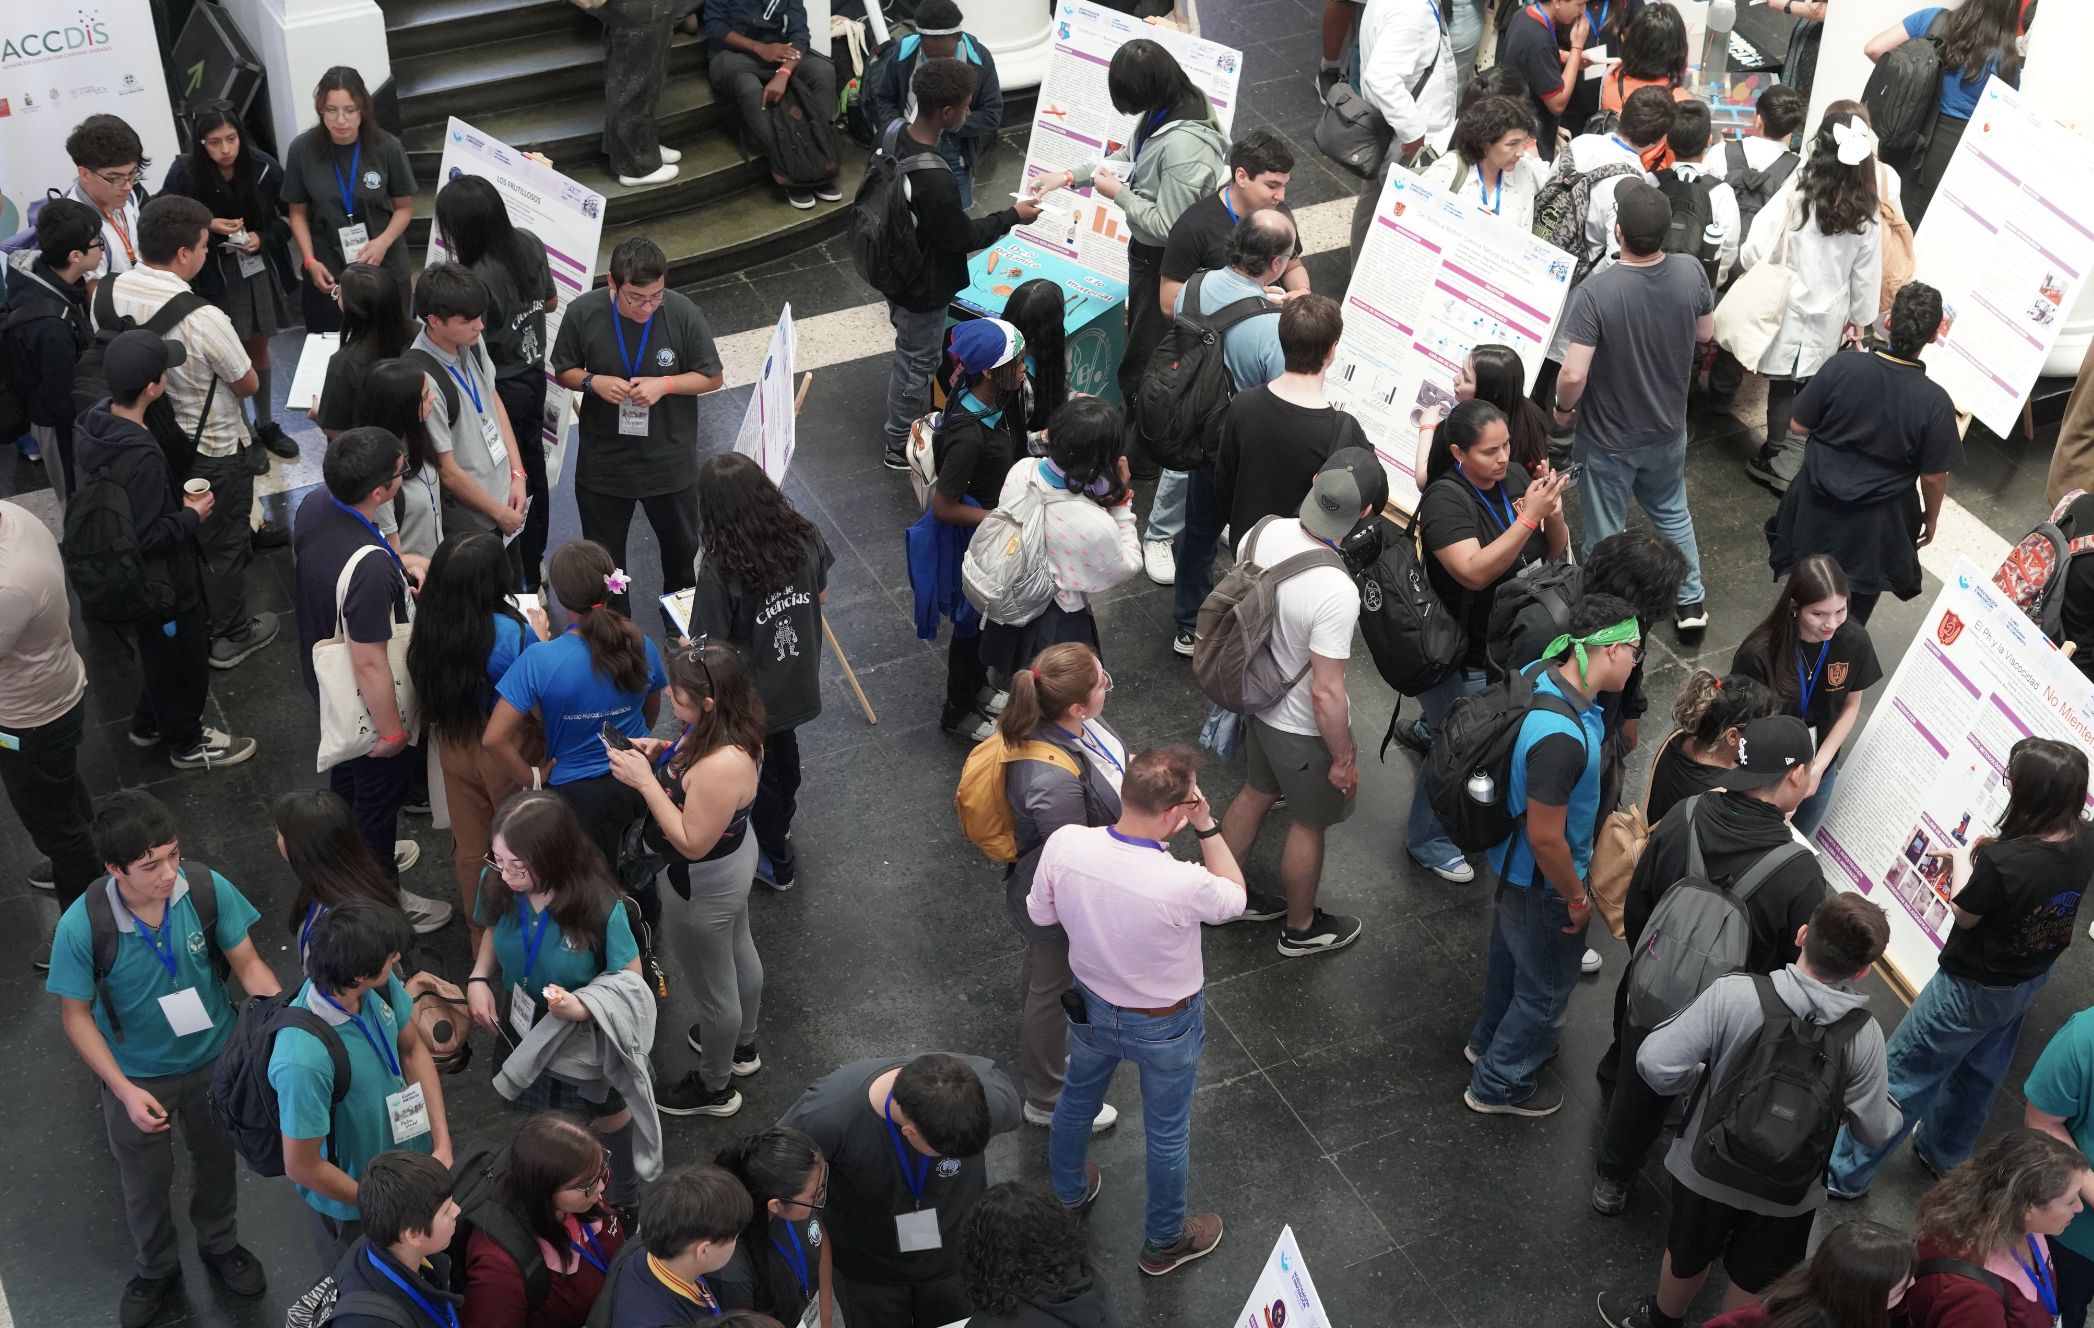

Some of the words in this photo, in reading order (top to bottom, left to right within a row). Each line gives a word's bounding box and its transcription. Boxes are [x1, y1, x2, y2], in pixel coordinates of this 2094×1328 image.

[2, 22, 109, 62] ACCDiS
[497, 175, 506, 186] LOS
[508, 181, 541, 204] FRUTILLOSOS
[1066, 280, 1114, 302] material
[756, 592, 810, 624] Ciencias
[1974, 620, 1982, 632] El
[1983, 627, 1992, 642] Ph
[1998, 644, 2005, 654] la
[2005, 650, 2040, 690] Viscocidad
[2043, 686, 2058, 707] No
[1979, 745, 2005, 774] METODOLÓGIC
